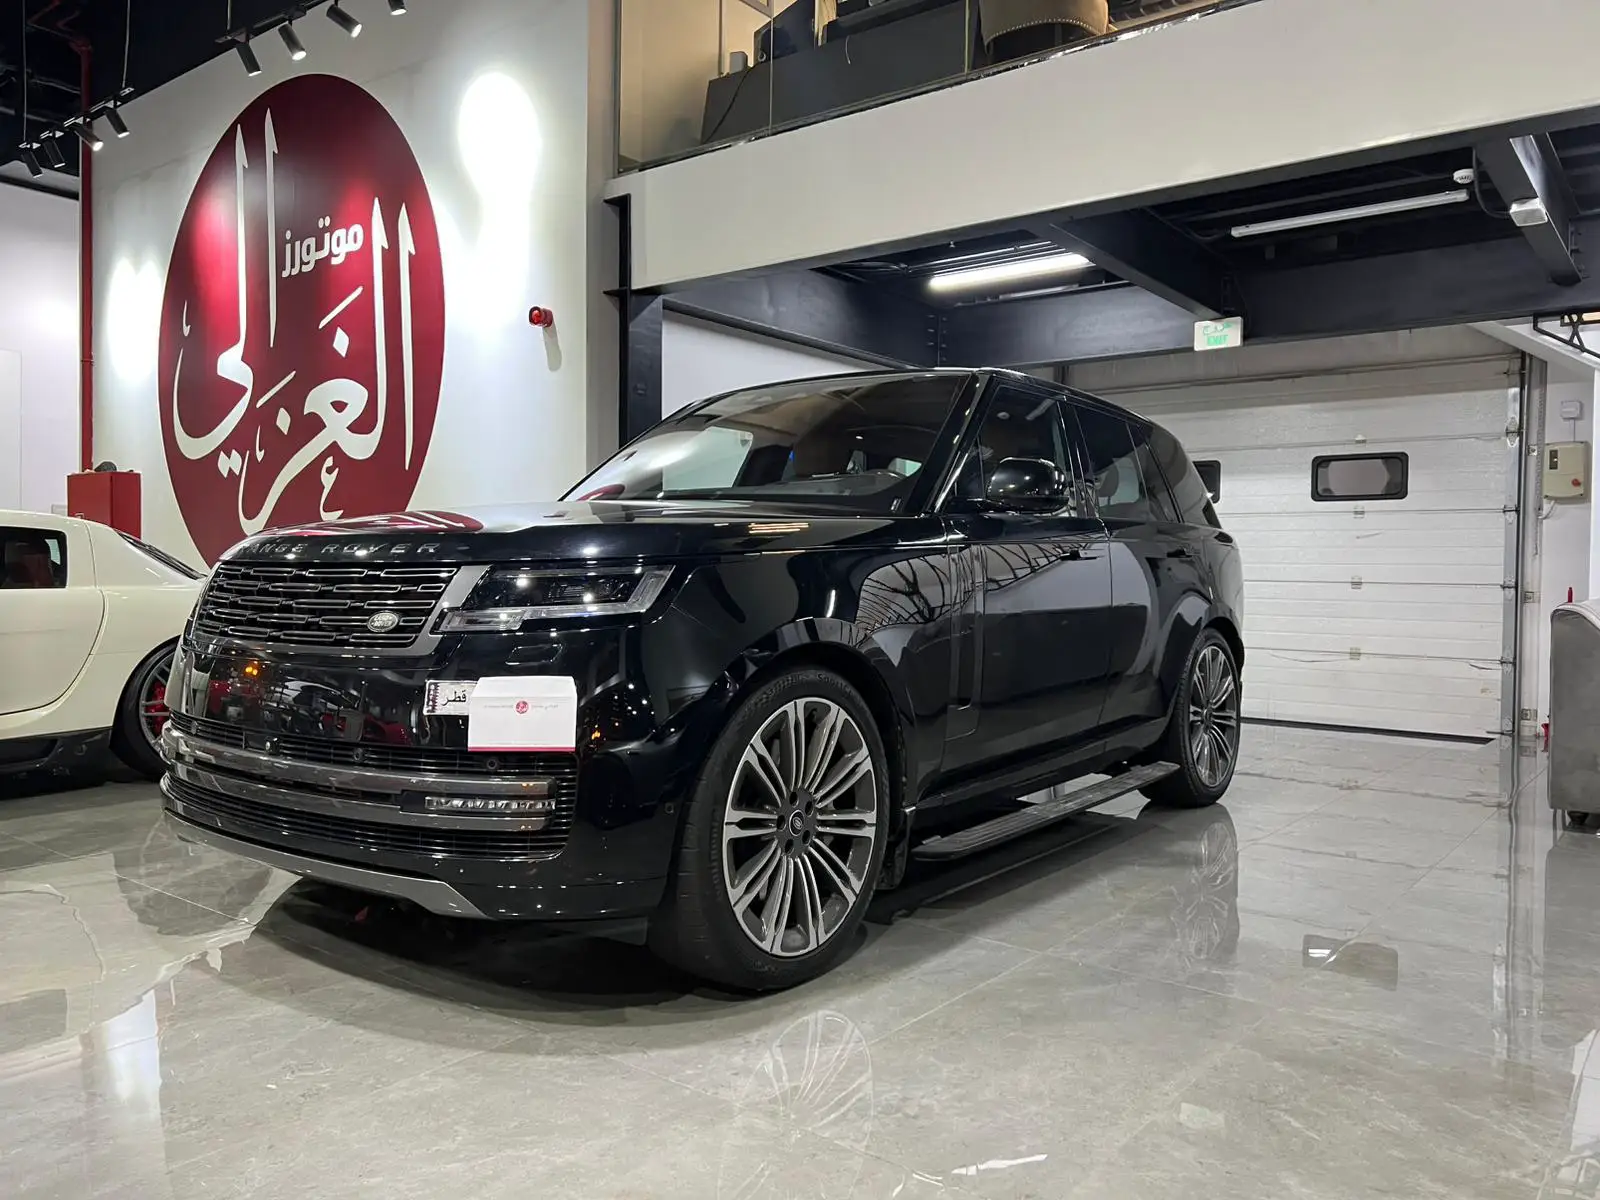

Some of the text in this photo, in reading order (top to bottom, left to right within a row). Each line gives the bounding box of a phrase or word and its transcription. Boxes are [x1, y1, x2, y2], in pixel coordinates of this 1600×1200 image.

[281, 215, 364, 278] موتورز
[321, 543, 441, 554] ROVER
[441, 690, 467, 706] قطر
